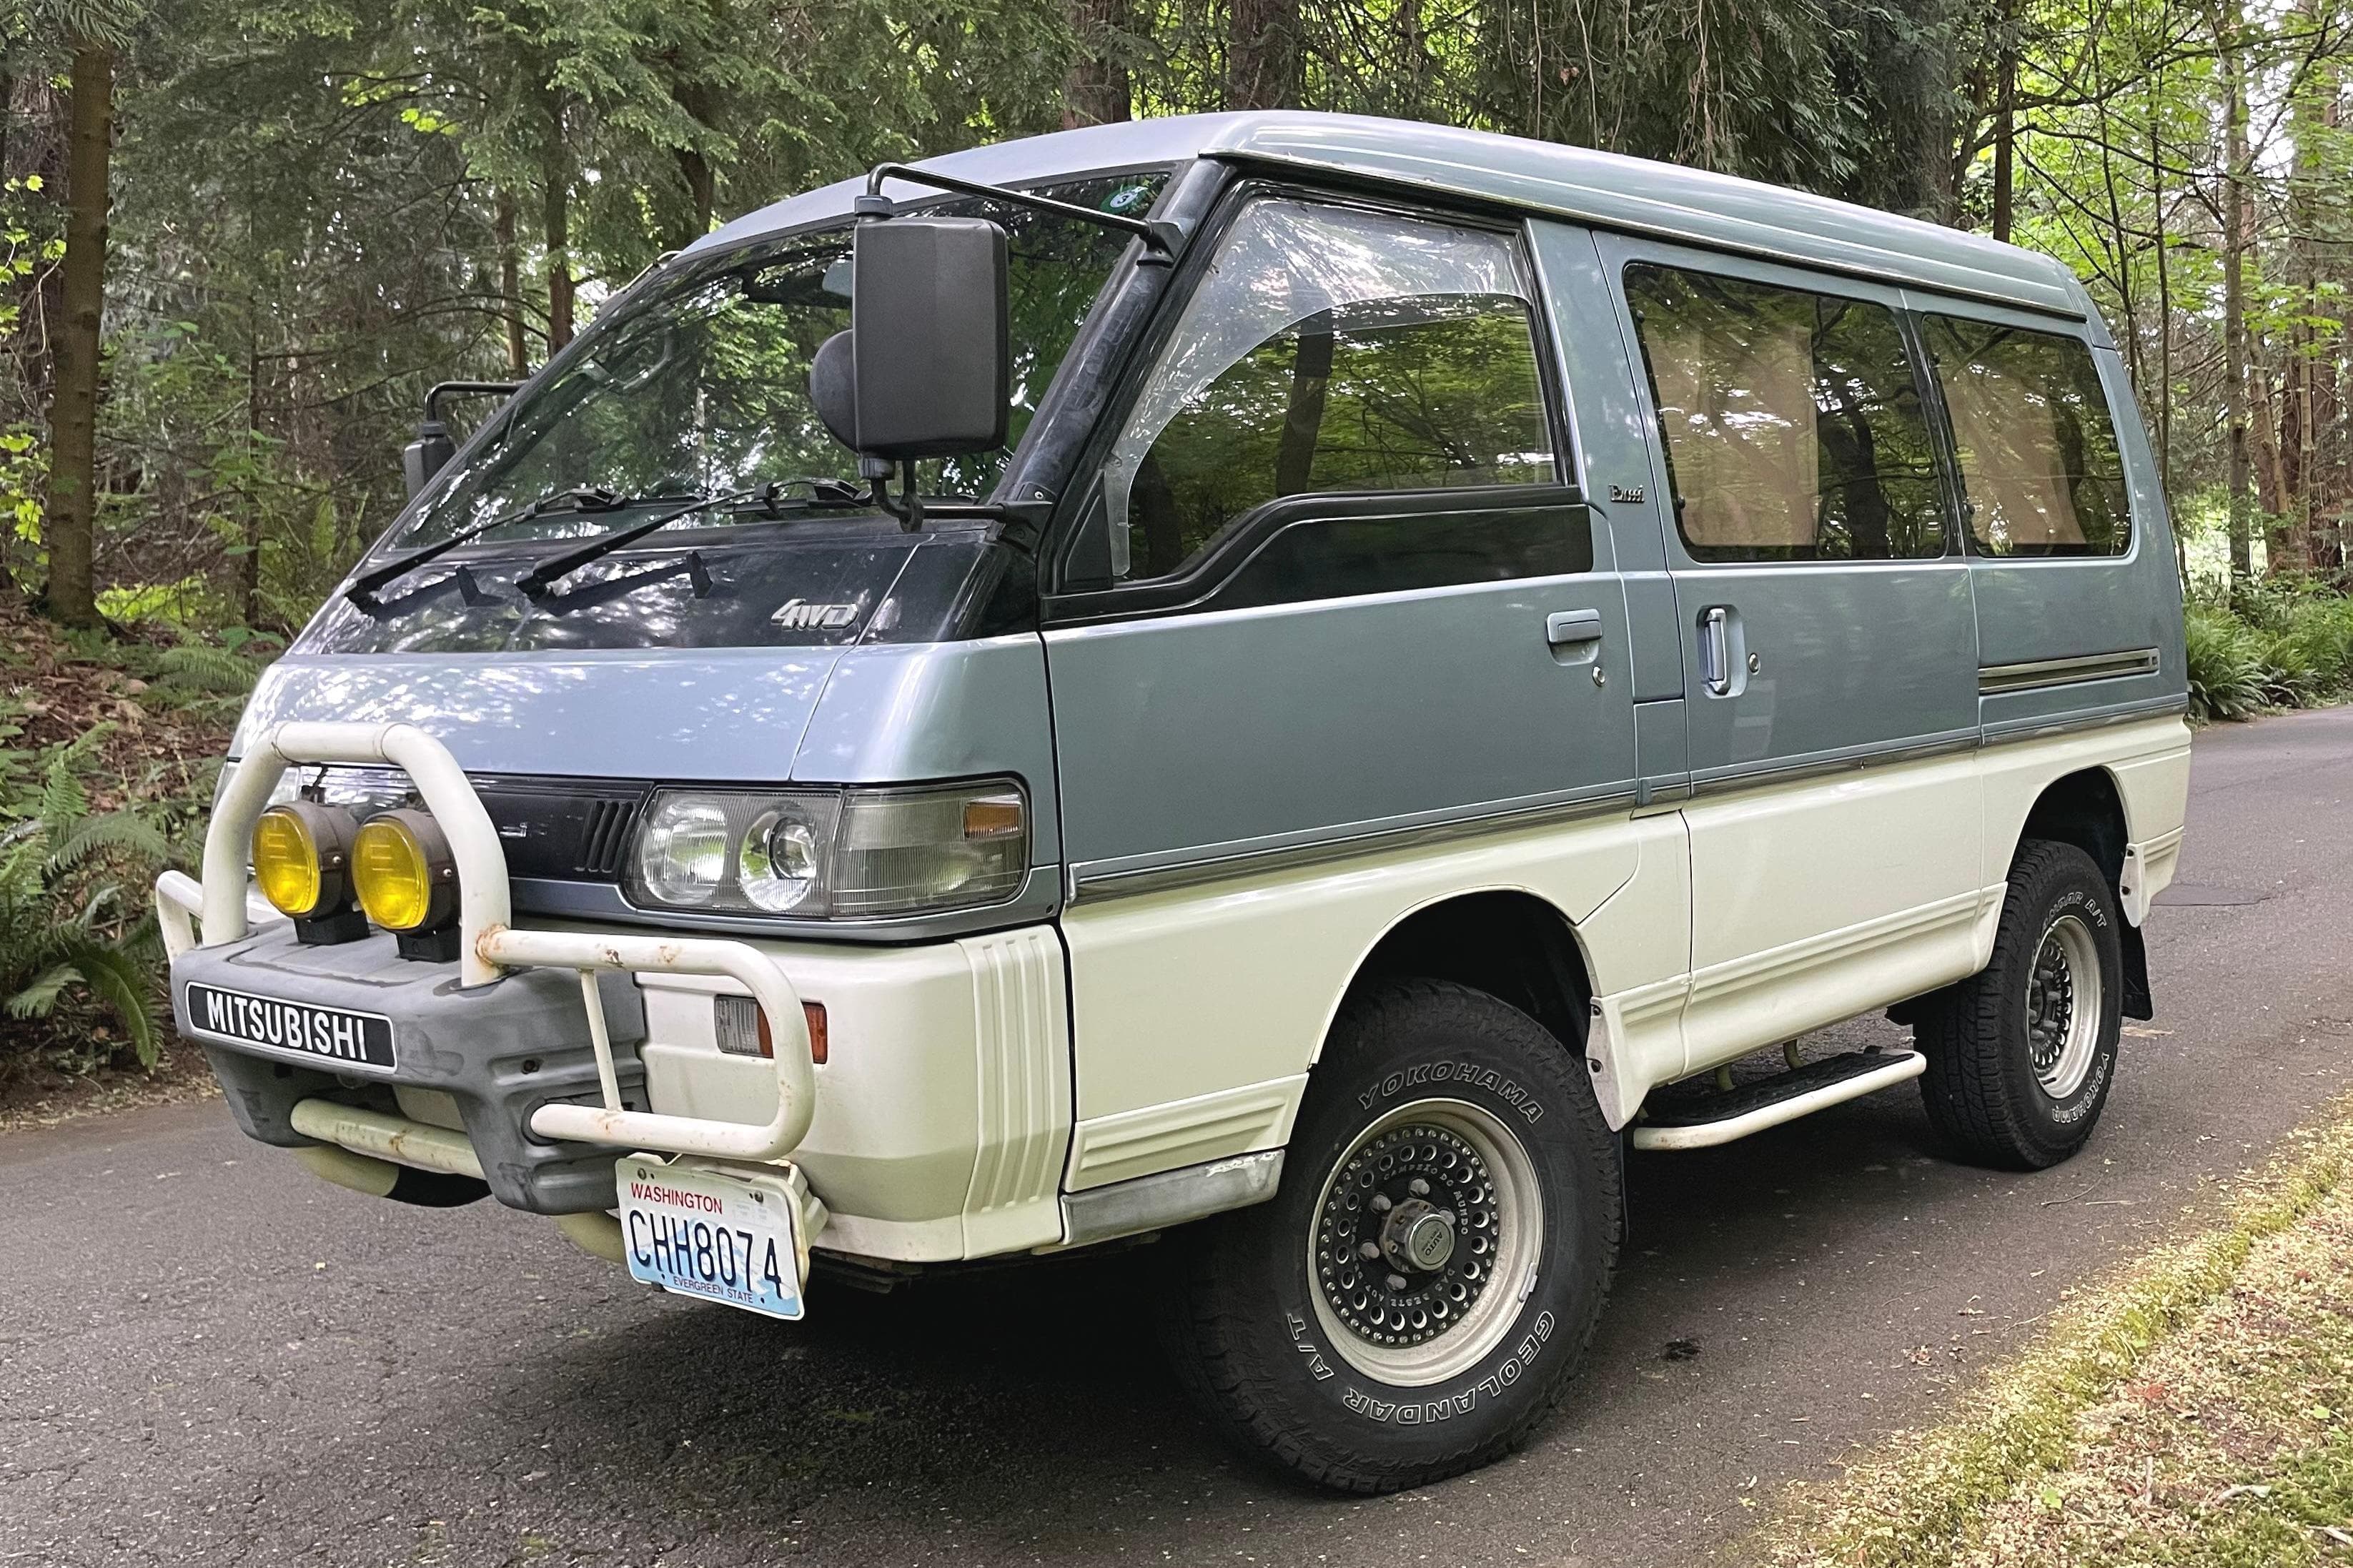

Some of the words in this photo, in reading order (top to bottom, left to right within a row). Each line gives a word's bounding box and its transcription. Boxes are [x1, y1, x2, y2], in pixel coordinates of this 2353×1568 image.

[771, 598, 858, 630] 4WD
[206, 991, 368, 1061] MITSUBISHI
[1359, 1061, 1544, 1124] YOKOHAMA
[2051, 1052, 2110, 1123] YOKOHAMA
[631, 1183, 723, 1214] WASHINGTON
[629, 1209, 784, 1300] CHH8074
[1425, 1231, 1443, 1256] AUTO
[673, 1276, 724, 1296] EVERGREEN
[727, 1288, 753, 1304] STATE
[1342, 1310, 1556, 1425] GEOLANDAR
